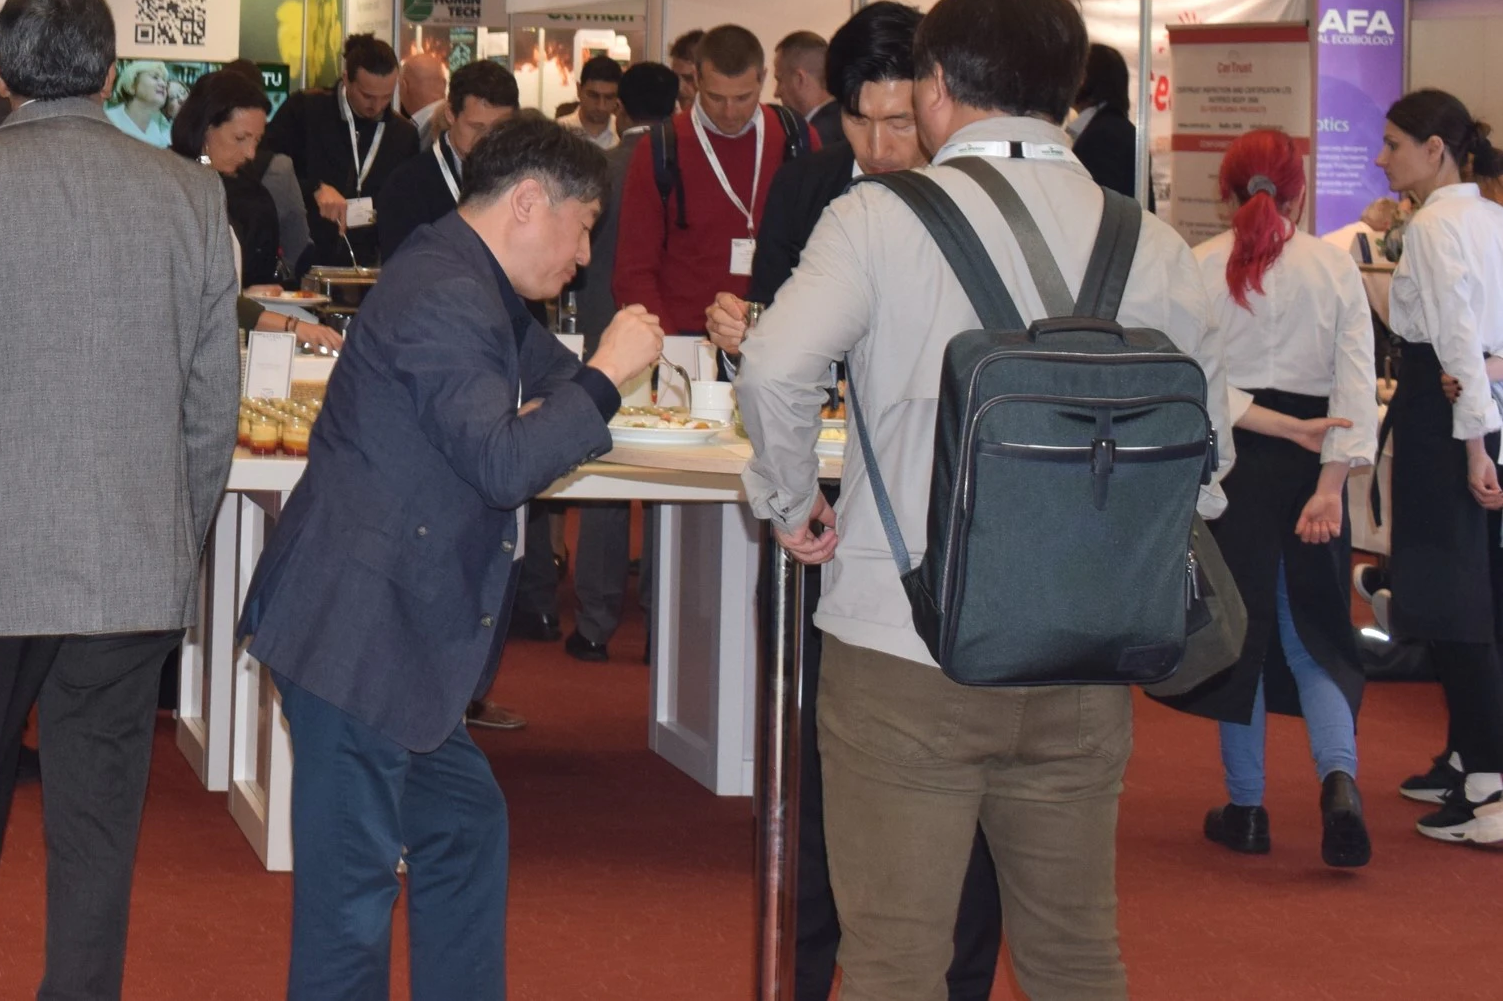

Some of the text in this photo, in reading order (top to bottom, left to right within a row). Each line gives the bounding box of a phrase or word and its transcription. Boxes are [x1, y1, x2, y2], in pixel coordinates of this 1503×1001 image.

[448, 6, 481, 17] TECH
[1318, 8, 1395, 35] AFA
[262, 71, 282, 87] TU
